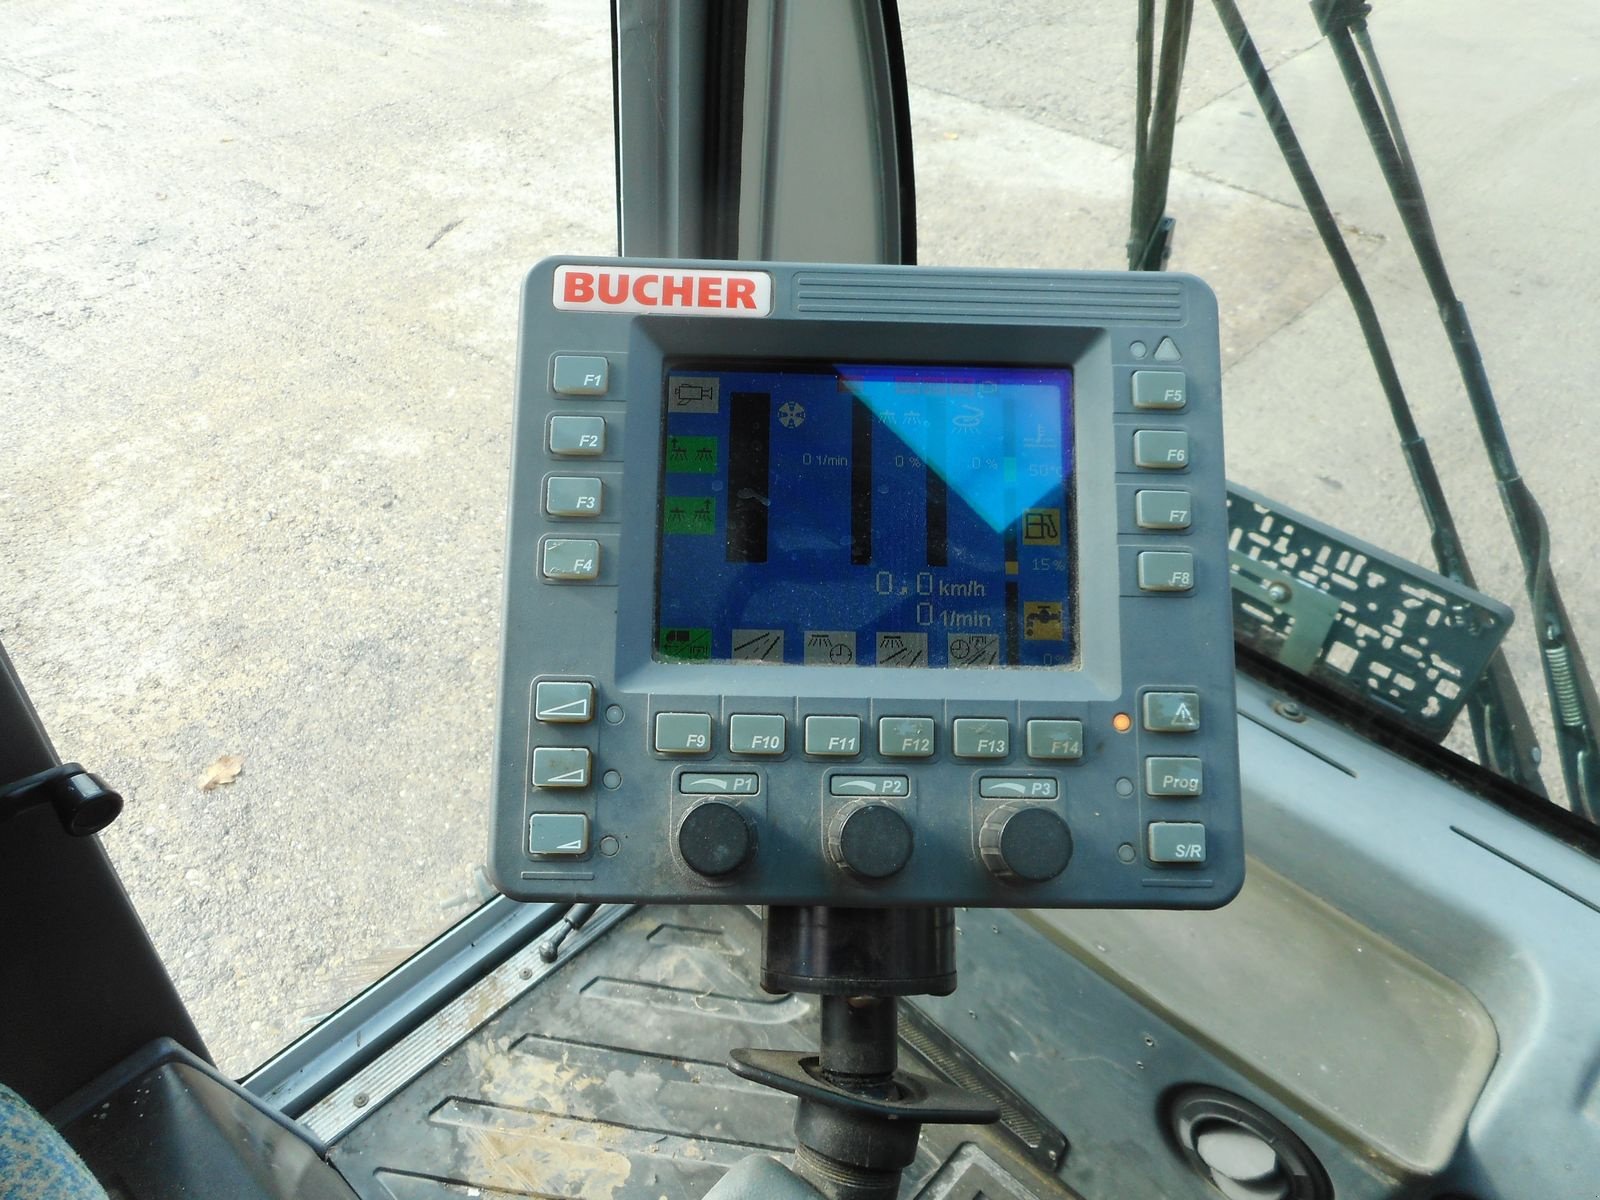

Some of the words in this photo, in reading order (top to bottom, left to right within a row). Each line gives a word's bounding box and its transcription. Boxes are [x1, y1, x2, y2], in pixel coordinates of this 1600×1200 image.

[563, 271, 757, 310] BUCHER
[583, 374, 602, 387] F1
[1164, 389, 1183, 402] F5
[579, 435, 599, 448] F2
[802, 453, 812, 465] 0
[895, 456, 904, 467] 0
[908, 456, 922, 468] %
[1167, 449, 1186, 462] F6
[576, 496, 596, 509] F3
[1169, 510, 1188, 523] F7
[573, 559, 593, 572] F4
[1031, 558, 1051, 571] 15
[876, 571, 933, 596] 0.0
[939, 580, 986, 597] km/h
[1171, 572, 1190, 587] F8
[916, 602, 934, 626] 0
[940, 610, 992, 628] 1/min
[686, 734, 706, 748] F9
[751, 736, 780, 749] F10
[828, 737, 856, 750] F11
[901, 738, 930, 751] F12
[977, 739, 1006, 753] F13
[1051, 740, 1080, 754] F14
[733, 778, 753, 791] P1
[881, 780, 902, 793] P2
[1031, 782, 1051, 795] P3
[1162, 775, 1199, 791] Prog
[1174, 843, 1202, 858] S/R
